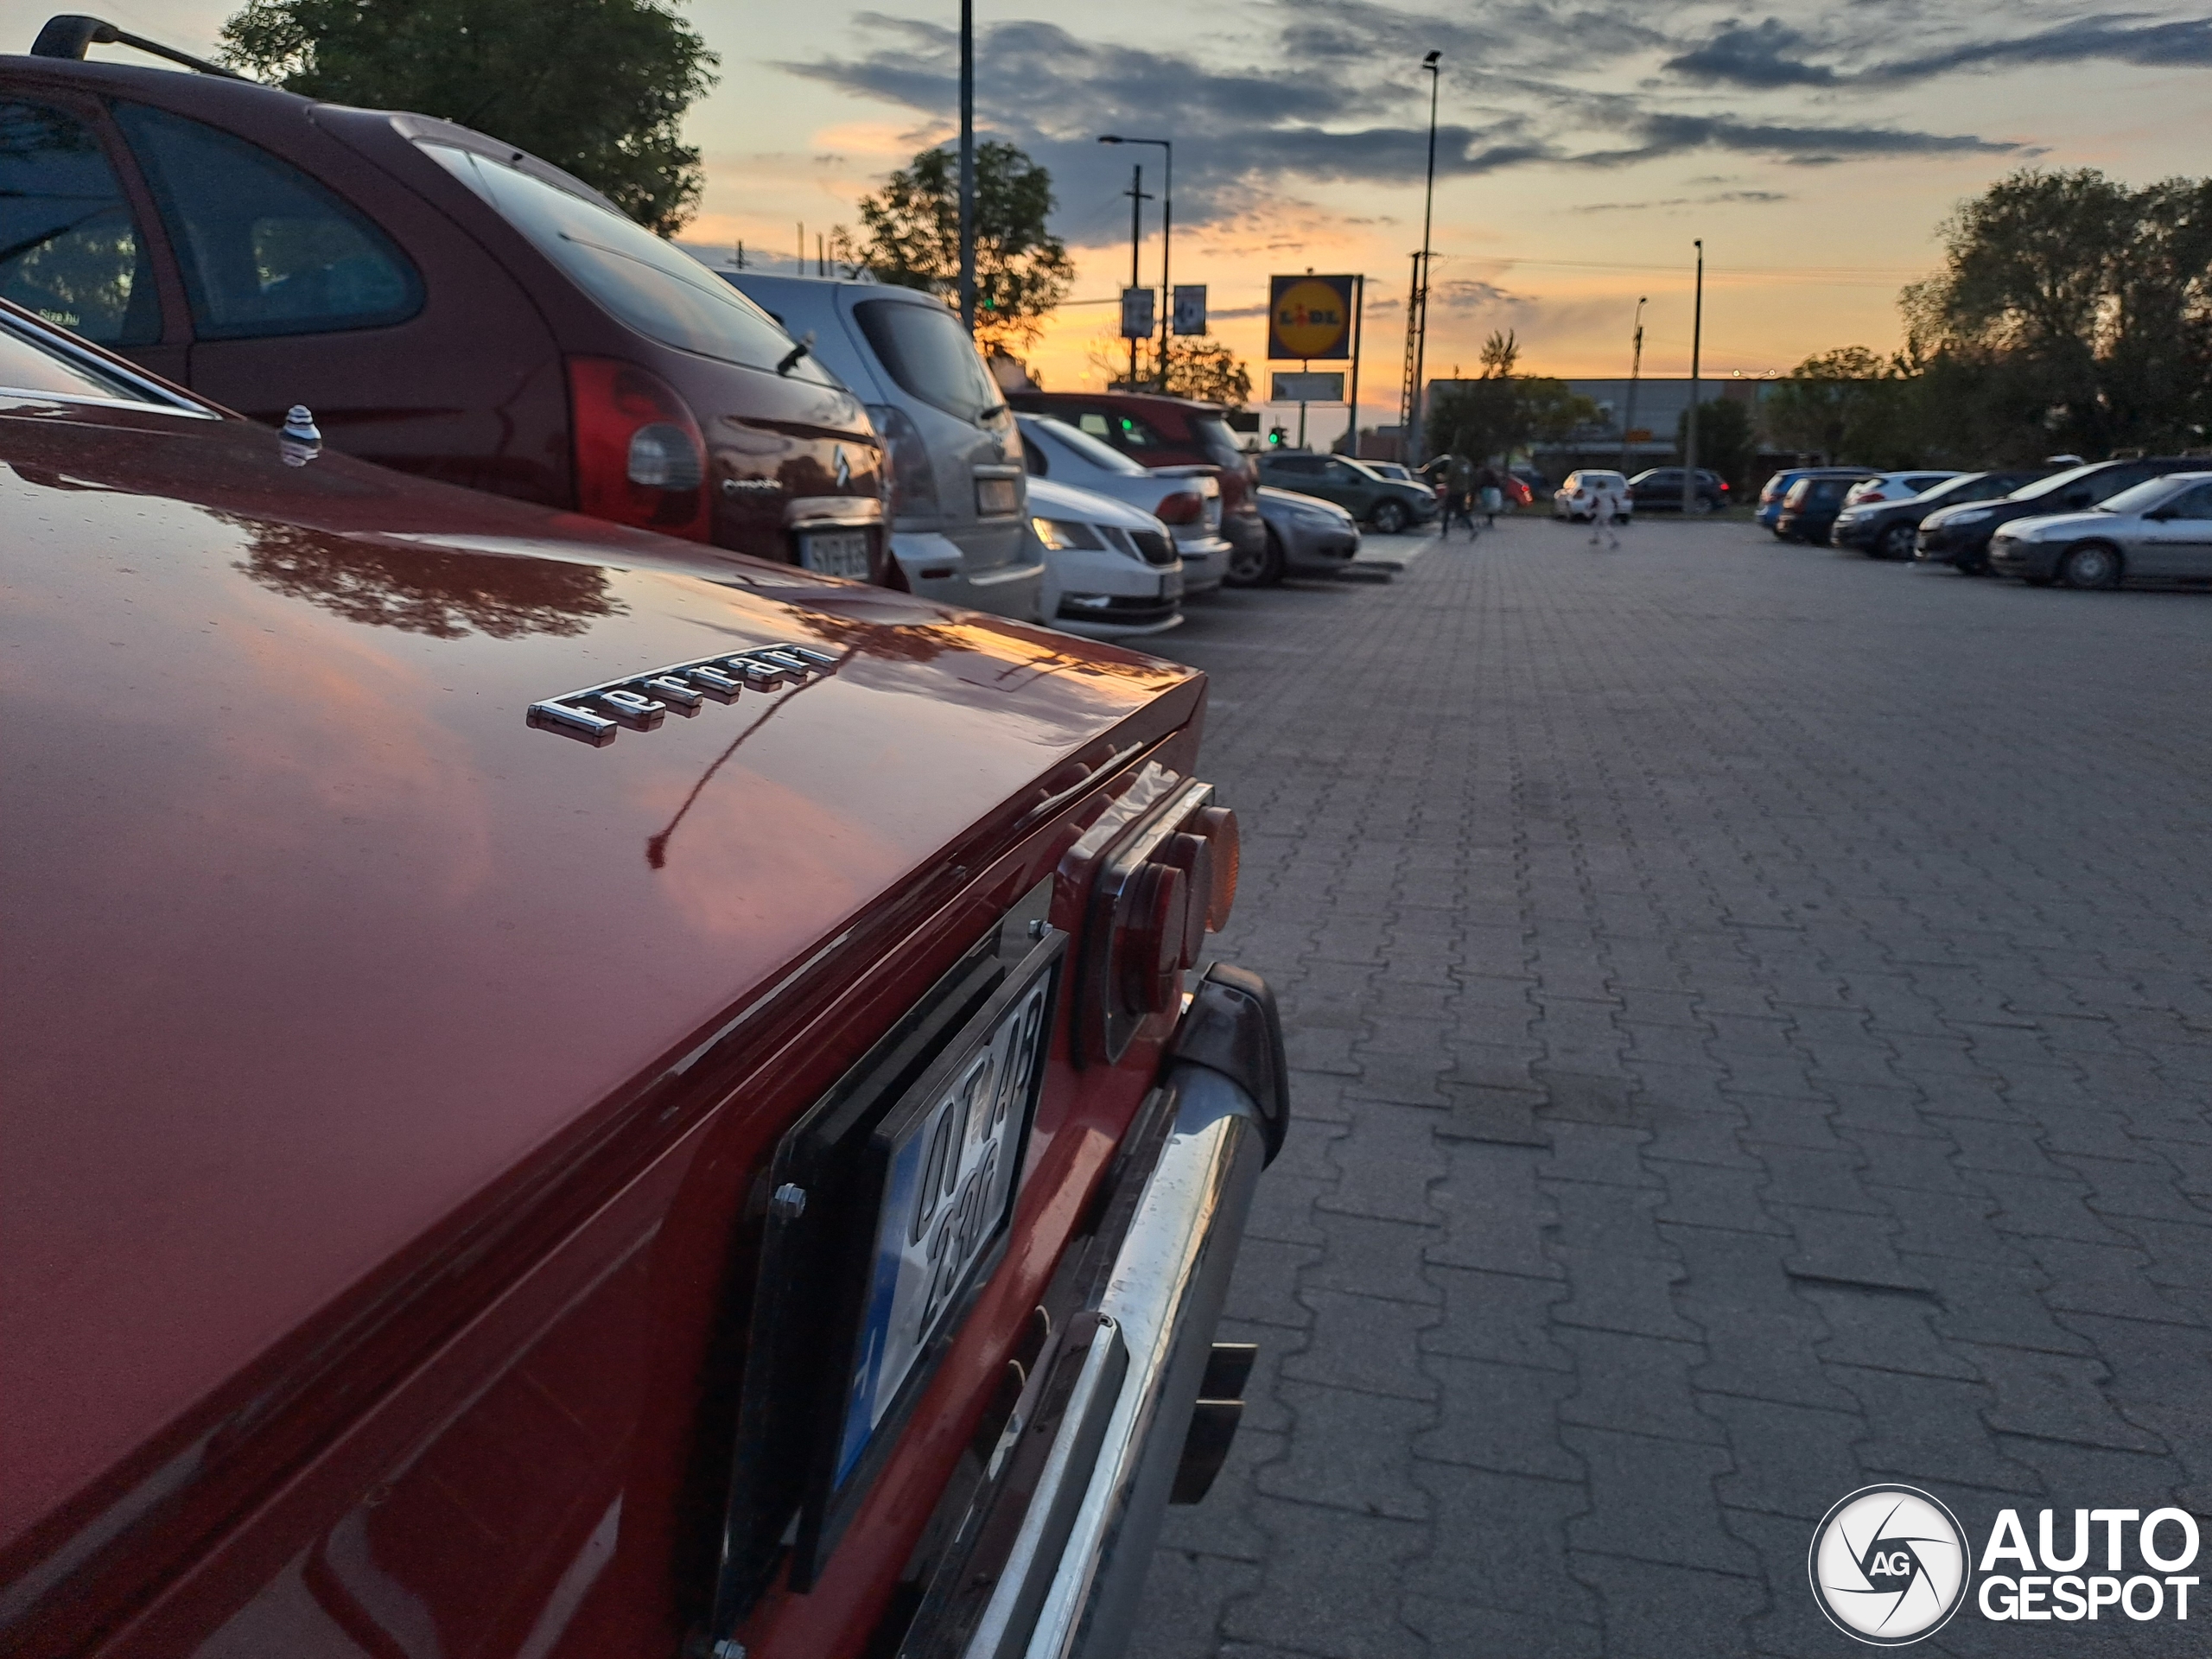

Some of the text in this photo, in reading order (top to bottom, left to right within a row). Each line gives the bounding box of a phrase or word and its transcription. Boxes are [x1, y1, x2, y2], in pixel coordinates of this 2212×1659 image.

[526, 643, 840, 748] Ferrari
[908, 989, 1042, 1248] OT AB
[916, 1137, 997, 1346] 236
